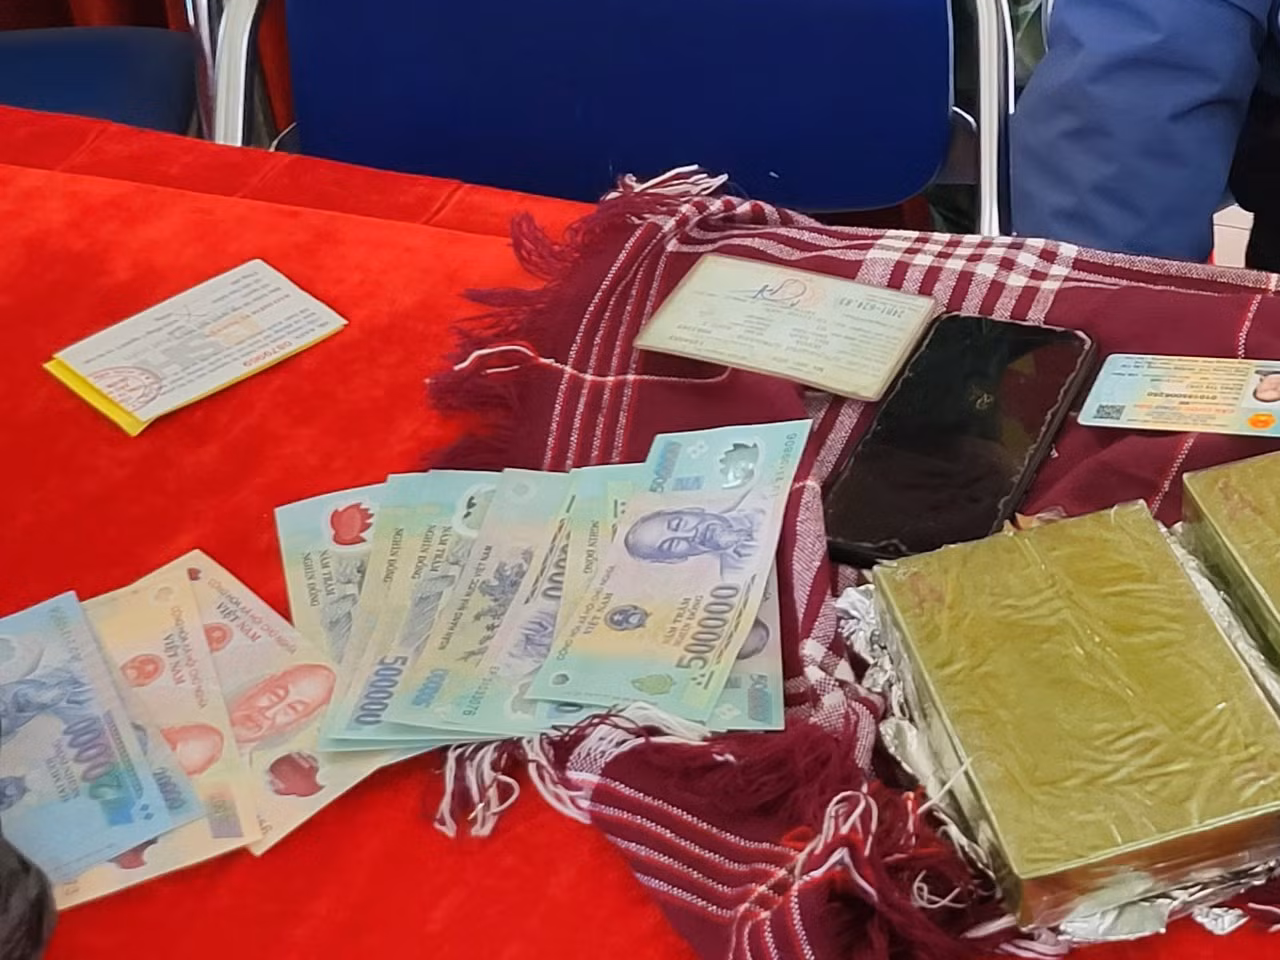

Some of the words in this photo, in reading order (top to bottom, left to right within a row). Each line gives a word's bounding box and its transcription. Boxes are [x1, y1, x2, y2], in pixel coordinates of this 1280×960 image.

[387, 526, 404, 559] NGHÌN
[479, 544, 493, 561] NAM
[302, 552, 317, 580] NGHÌN
[382, 559, 399, 584] ĐỒNG
[410, 554, 429, 580] ĐỒNG
[306, 582, 321, 607] ĐỒNG
[322, 570, 336, 596] TRĂM
[596, 590, 614, 614] NAM
[215, 600, 242, 624] VIỆT
[235, 619, 262, 643] NAM
[676, 587, 740, 670] 500000
[169, 659, 185, 685] NAM
[353, 656, 409, 723] 500000
[60, 715, 123, 803] 20000
